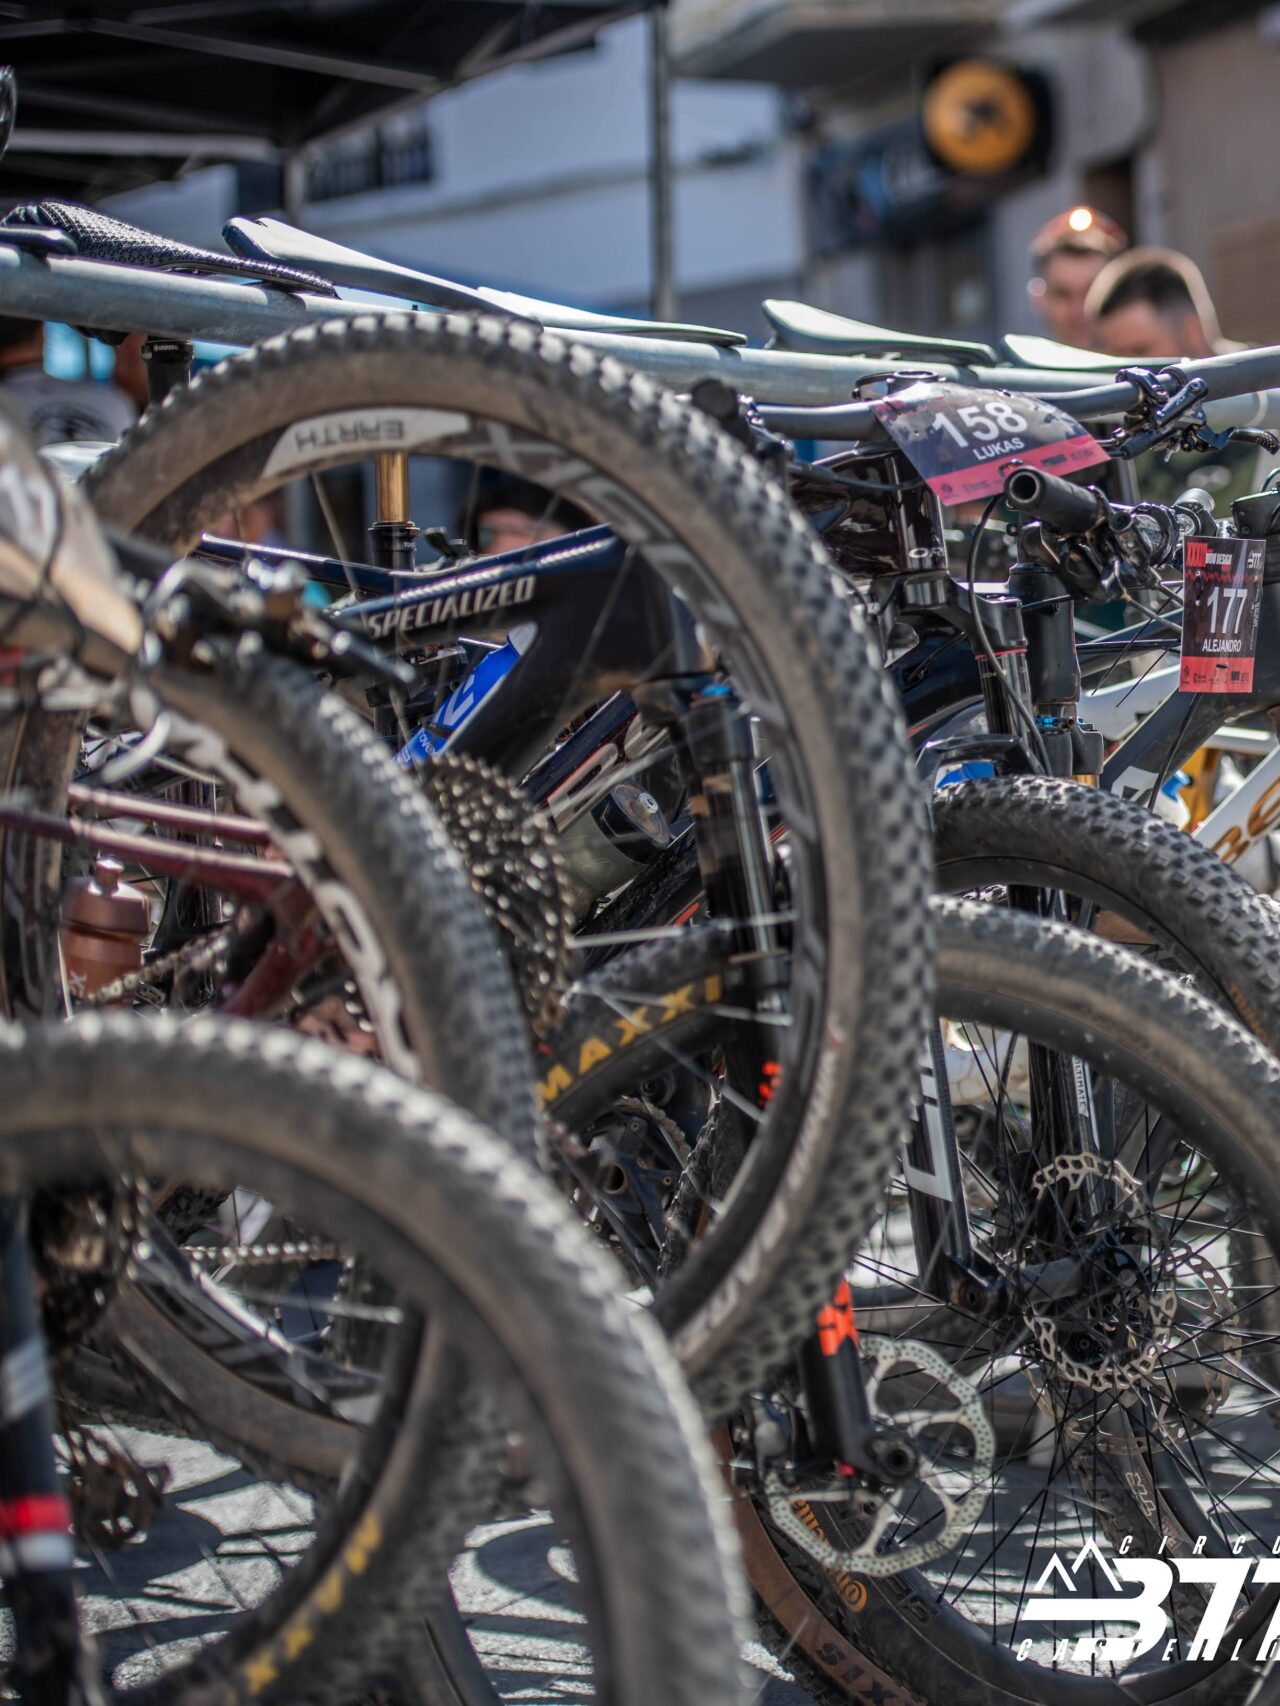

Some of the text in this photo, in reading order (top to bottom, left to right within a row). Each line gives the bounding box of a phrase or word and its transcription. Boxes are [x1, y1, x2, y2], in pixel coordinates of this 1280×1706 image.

[931, 402, 1028, 448] 158
[972, 437, 1025, 461] LUKAS
[367, 574, 537, 639] SPECIALIZED
[1207, 586, 1248, 634] 177
[1202, 638, 1242, 653] ALEJANDRO
[536, 974, 722, 1110] MAXXI
